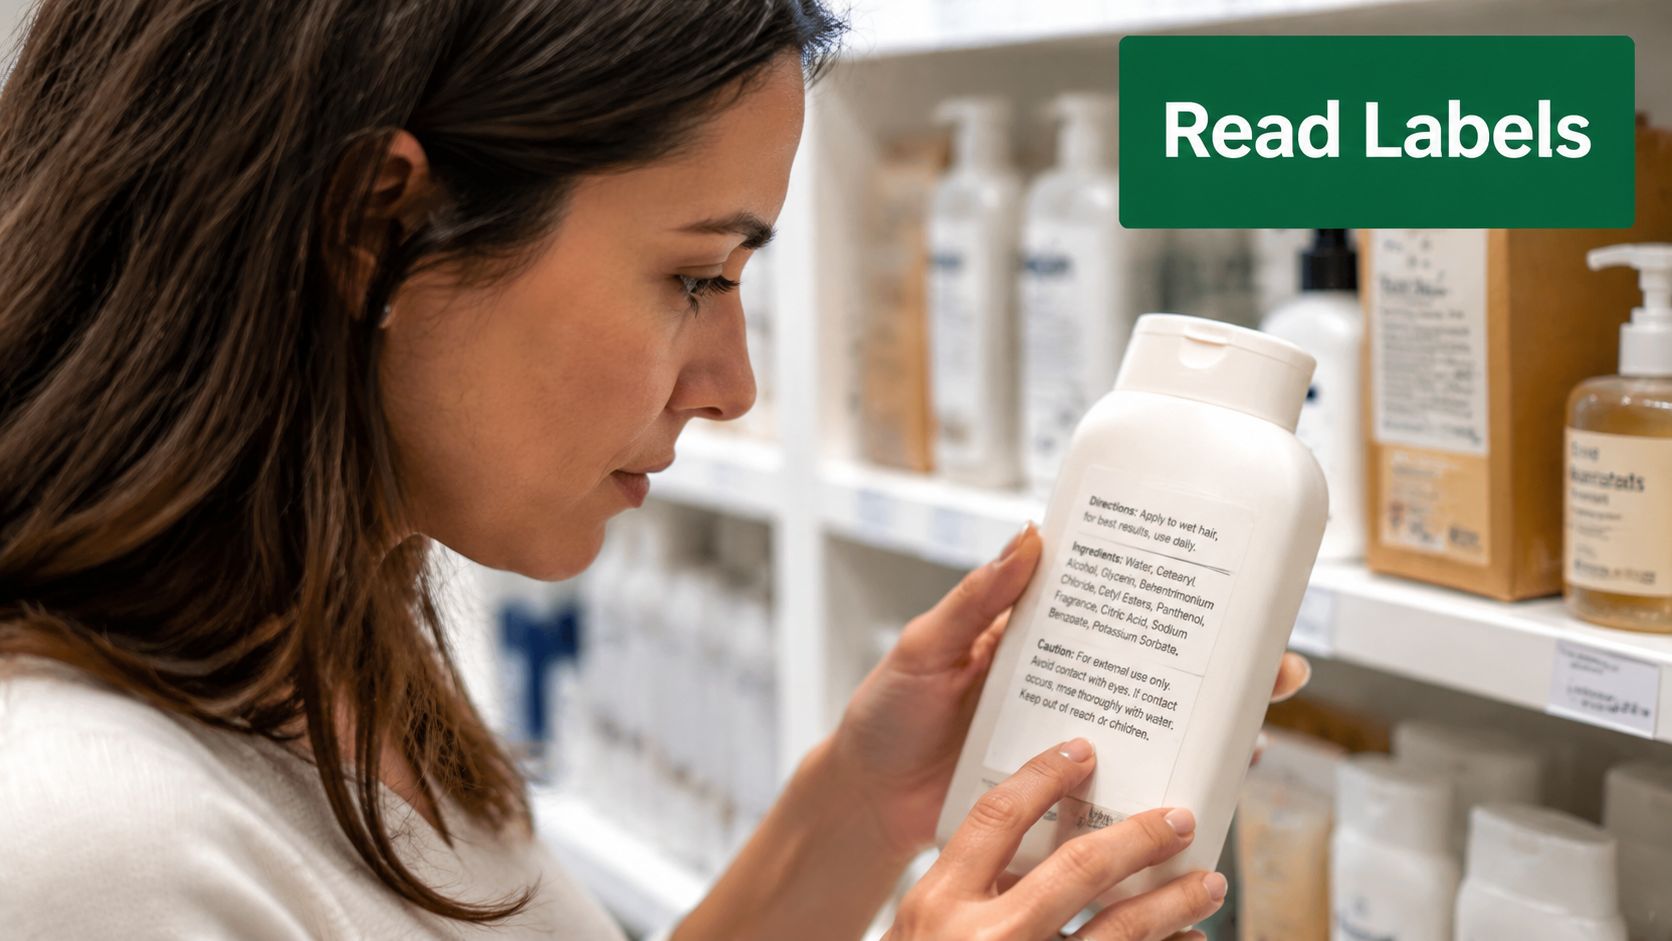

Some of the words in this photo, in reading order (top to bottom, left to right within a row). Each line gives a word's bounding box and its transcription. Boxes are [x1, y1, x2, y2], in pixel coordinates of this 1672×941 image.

[1083, 511, 1096, 523] for
[1097, 513, 1117, 529] best
[1118, 522, 1151, 540] results,
[1154, 531, 1171, 544] use
[1172, 534, 1196, 552] daily.
[1089, 495, 1137, 516] Directions:
[1140, 509, 1165, 526] Apply
[1167, 517, 1177, 528] to
[1179, 521, 1197, 534] wet
[1198, 524, 1219, 542] hair,
[1066, 558, 1098, 576] Alcohol,
[1139, 579, 1215, 610] Behentrimonium
[1072, 541, 1124, 564] Ingredients:
[1125, 556, 1154, 575] Water,
[1054, 590, 1098, 613] Fragrance,
[1100, 604, 1125, 620] Citric
[1126, 612, 1148, 629] Acid,
[1151, 620, 1188, 639] Sodium
[1060, 574, 1096, 594] Chloride,
[1098, 585, 1121, 601] Cetyl
[1122, 592, 1153, 612] Esters,
[1156, 602, 1205, 627] Panthenol,
[1048, 607, 1090, 630] Benzoate,
[1091, 620, 1137, 643] Potassium
[1139, 635, 1179, 656] Sorbate.
[1030, 655, 1055, 672] Avoid
[1055, 664, 1087, 681] contact
[1088, 674, 1107, 689] with
[1108, 681, 1130, 697] eyes.
[1133, 687, 1140, 699] If
[1141, 692, 1178, 711] contact
[1037, 638, 1075, 659] Caution:
[1076, 651, 1092, 665] For
[1093, 659, 1130, 677] external
[1130, 671, 1148, 683] use
[1150, 675, 1170, 691] only.
[1019, 688, 1041, 705] Keep
[1042, 698, 1057, 710] out
[1058, 701, 1069, 713] of
[1070, 706, 1095, 723] reach
[1109, 718, 1149, 741] children.
[1025, 673, 1054, 691] occurs,
[1056, 681, 1077, 697] rinse
[1077, 689, 1123, 714] thoroughly
[1125, 705, 1144, 719] with
[1145, 712, 1174, 730] water.
